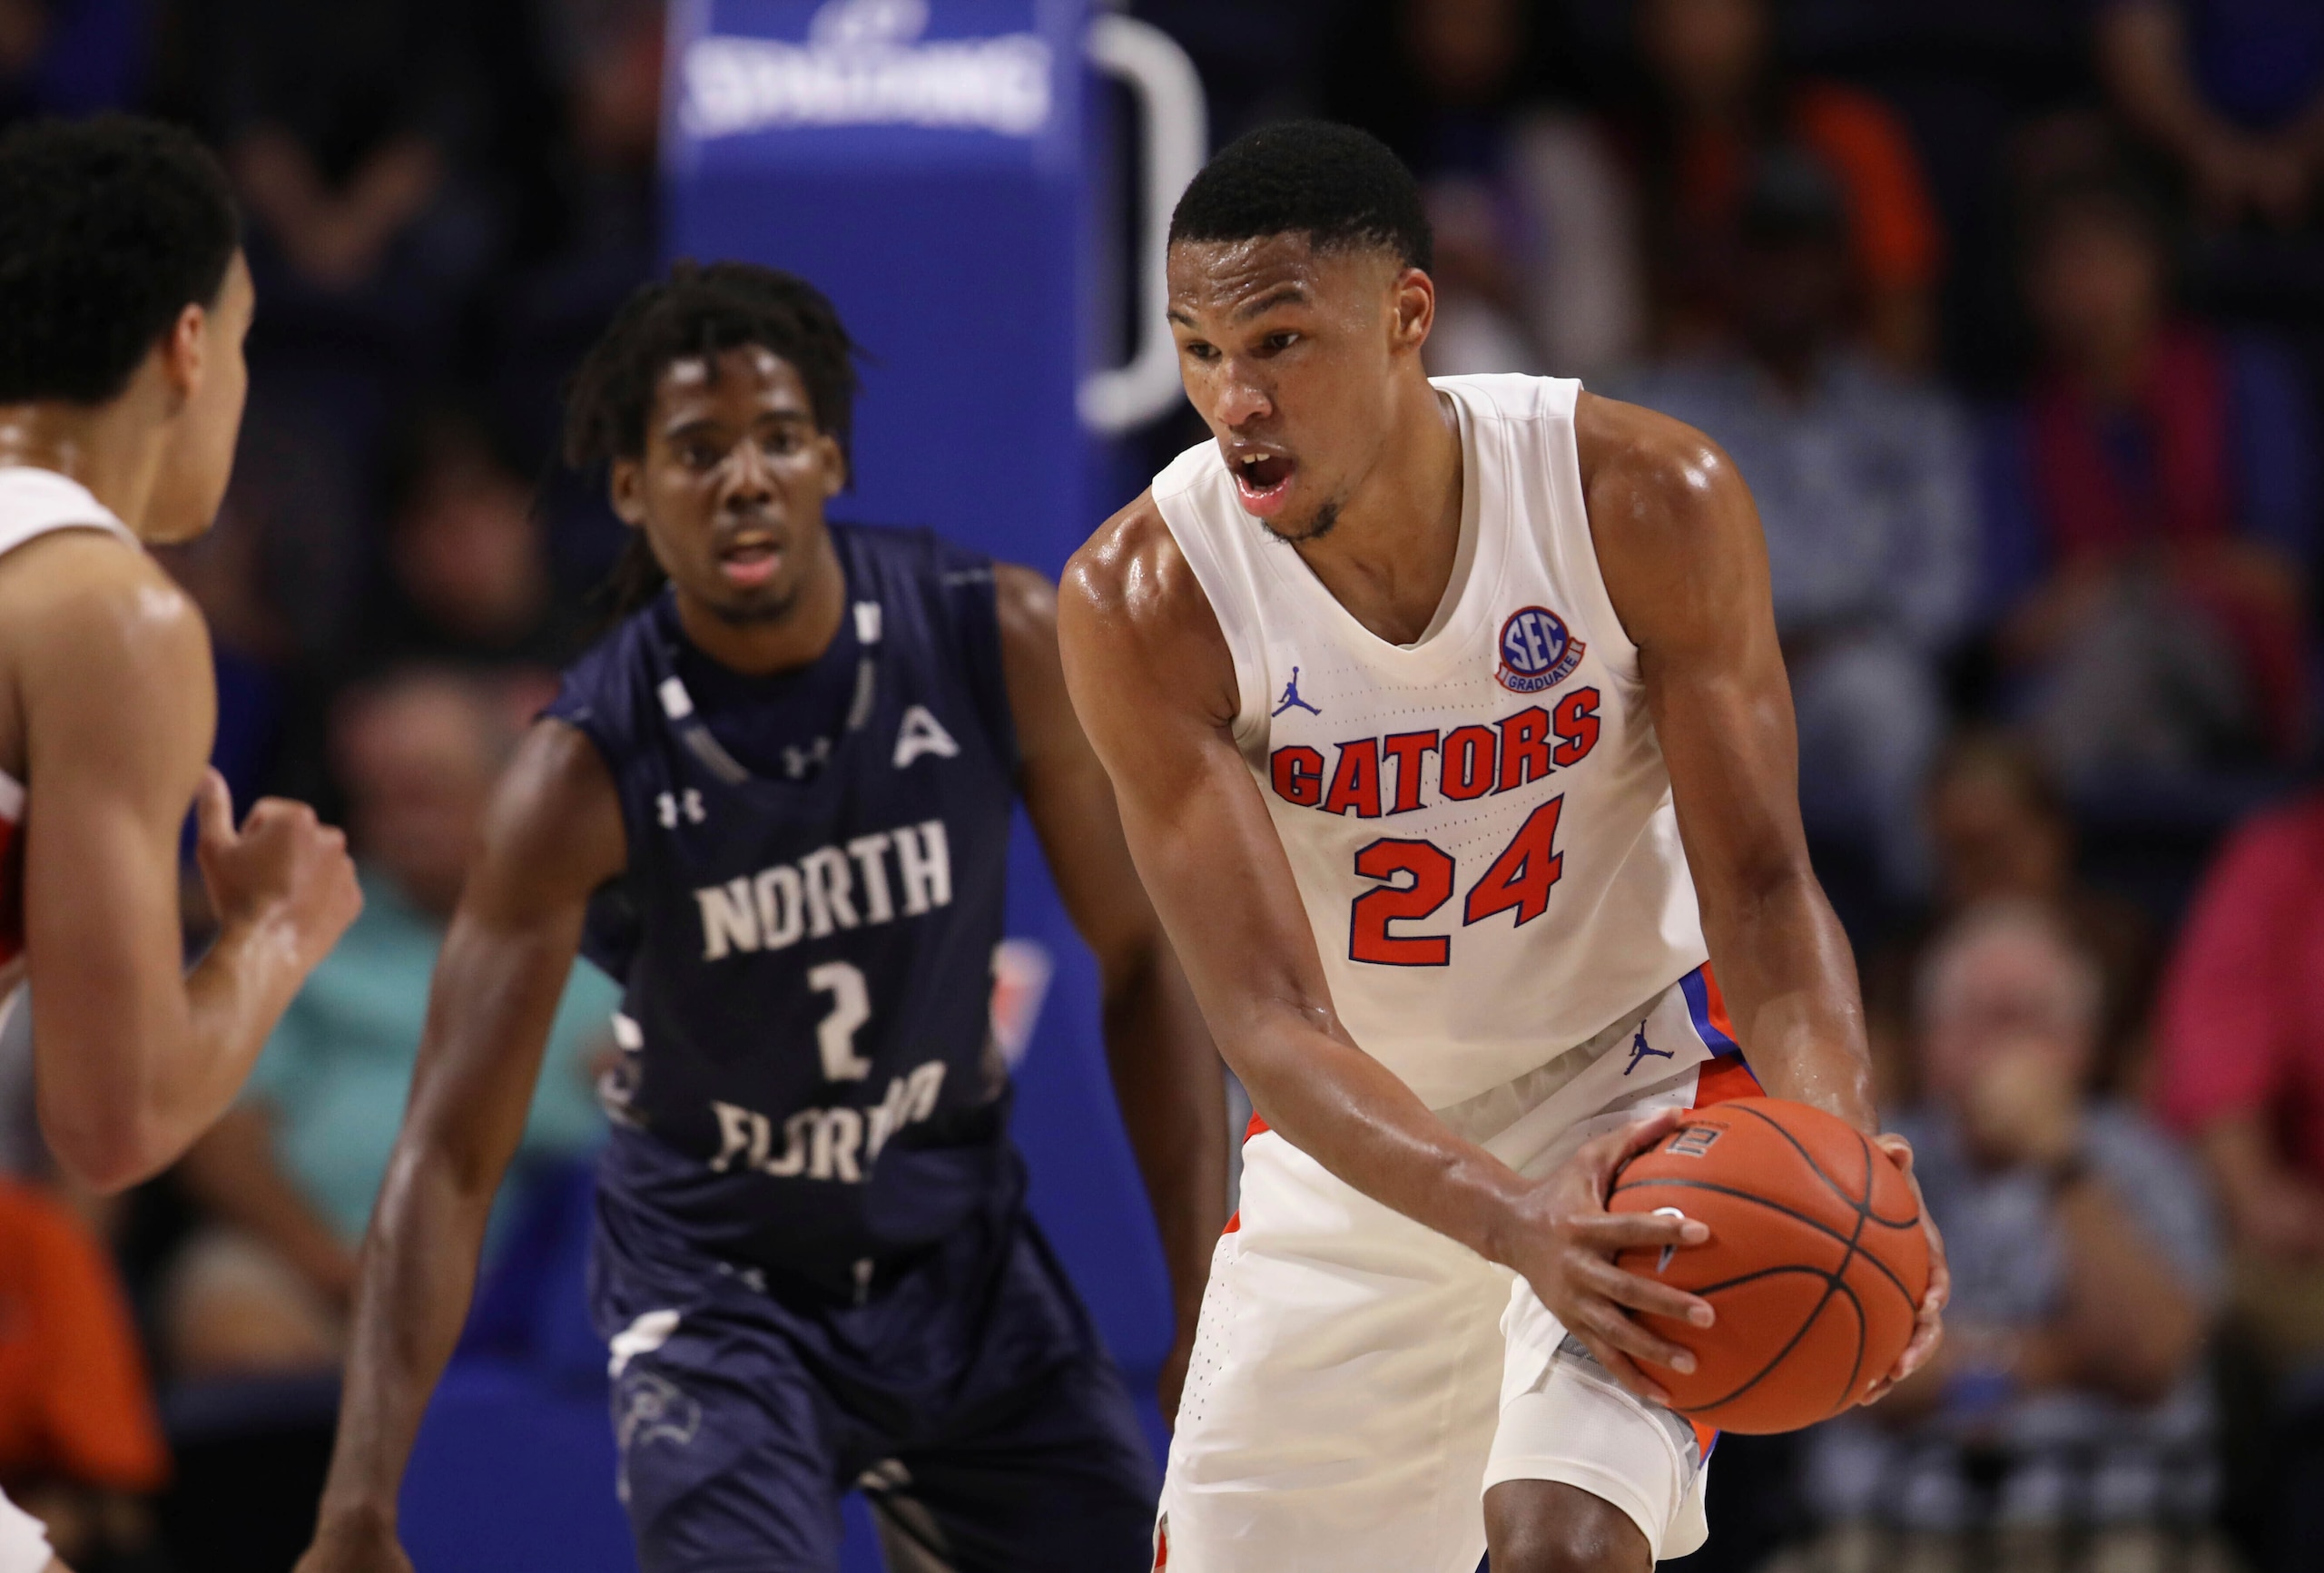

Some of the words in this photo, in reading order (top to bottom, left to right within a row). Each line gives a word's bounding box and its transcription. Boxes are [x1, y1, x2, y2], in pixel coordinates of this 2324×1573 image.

[1505, 612, 1563, 672] SEC
[1508, 655, 1578, 691] GRADUATE
[1271, 686, 1600, 818] GATORS
[695, 820, 951, 961] NORTH
[1349, 792, 1564, 966] 24
[808, 961, 872, 1081] 2
